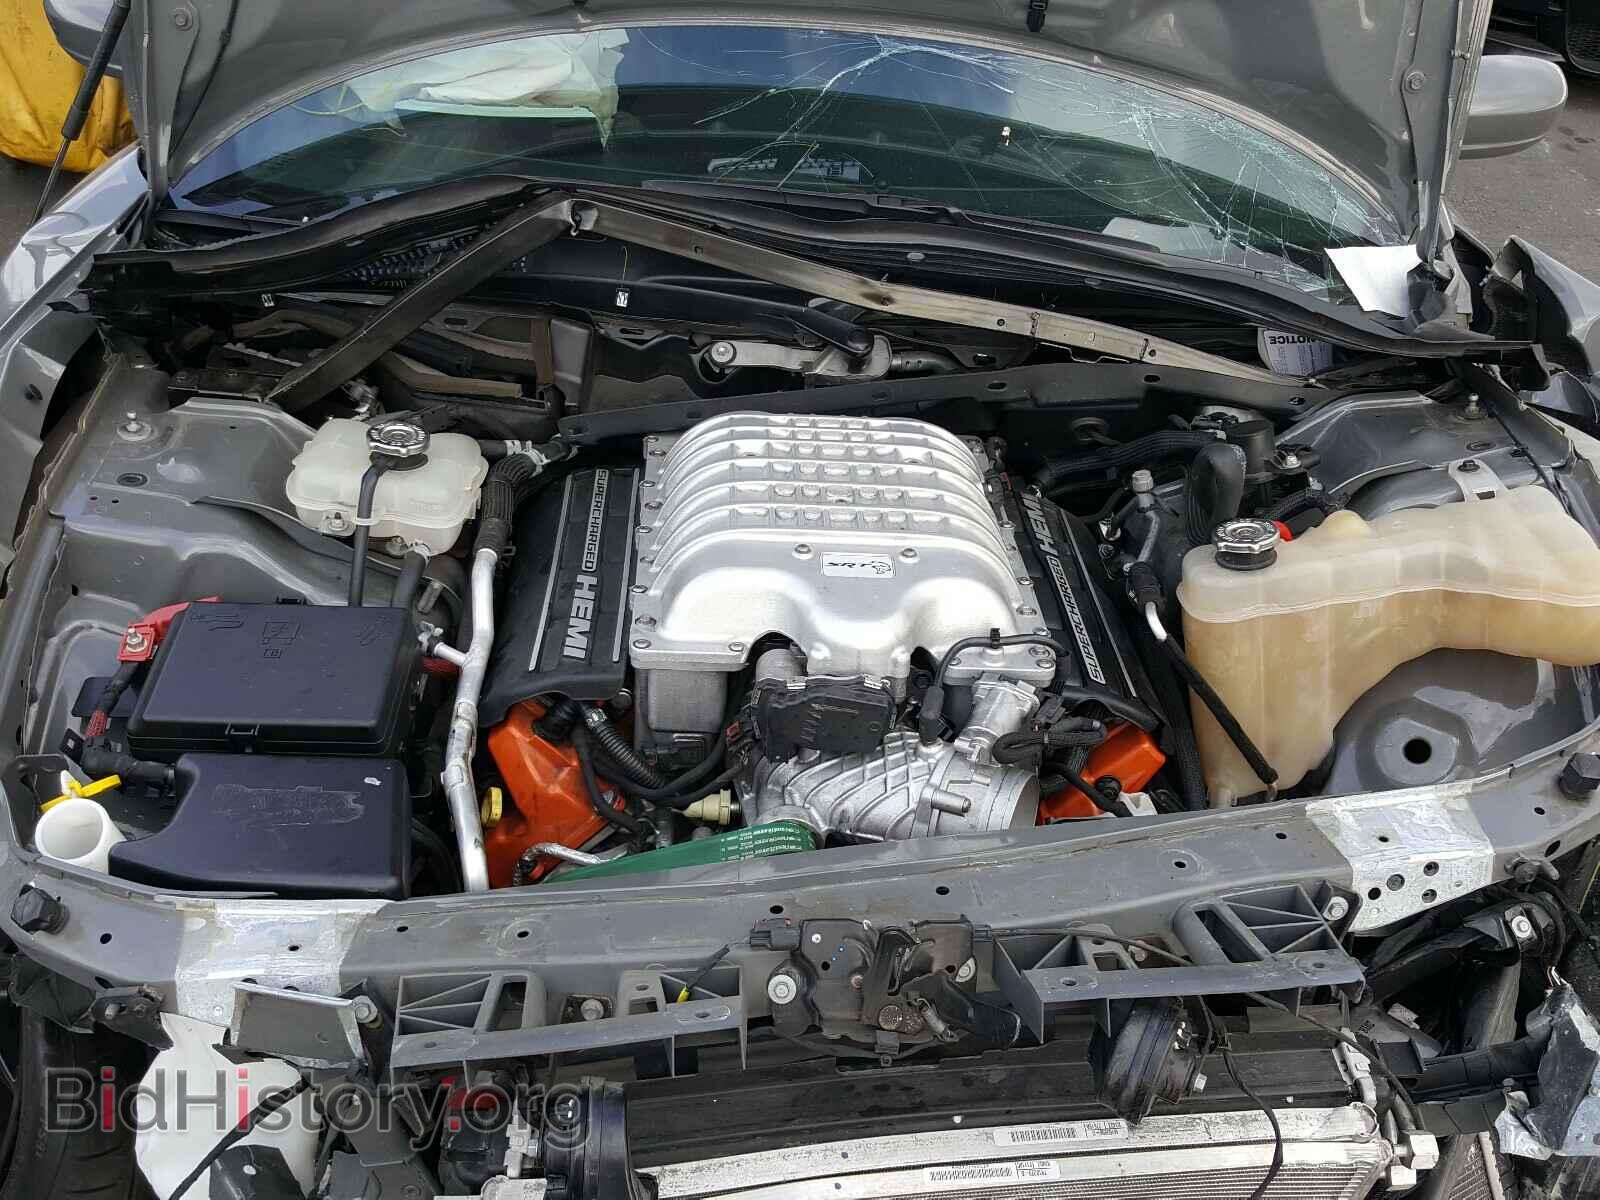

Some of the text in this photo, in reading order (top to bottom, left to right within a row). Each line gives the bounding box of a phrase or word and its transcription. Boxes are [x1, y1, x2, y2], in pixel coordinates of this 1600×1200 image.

[562, 470, 608, 661] SUPERCHARGED HEMI
[1021, 492, 1105, 684] SUPERCHARGED HEMI
